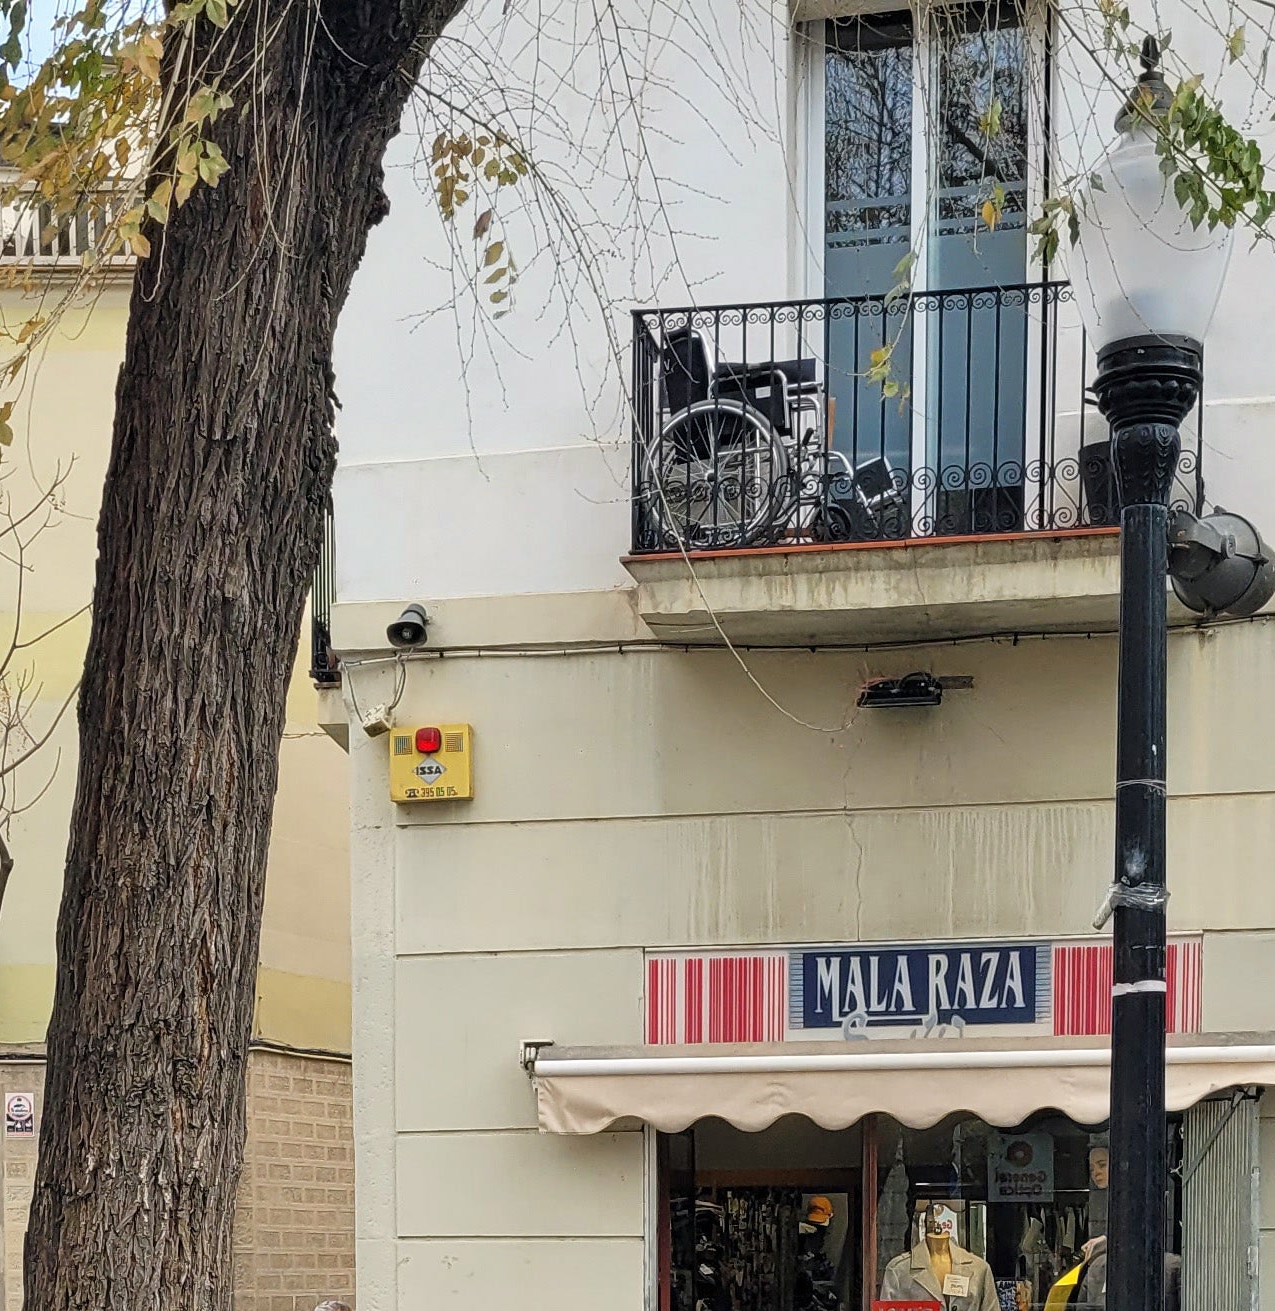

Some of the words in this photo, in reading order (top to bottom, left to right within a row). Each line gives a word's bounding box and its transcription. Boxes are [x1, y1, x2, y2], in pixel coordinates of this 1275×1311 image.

[416, 766, 442, 776] ISSA
[814, 954, 917, 1021] MALA
[927, 951, 1026, 1018] RAZA
